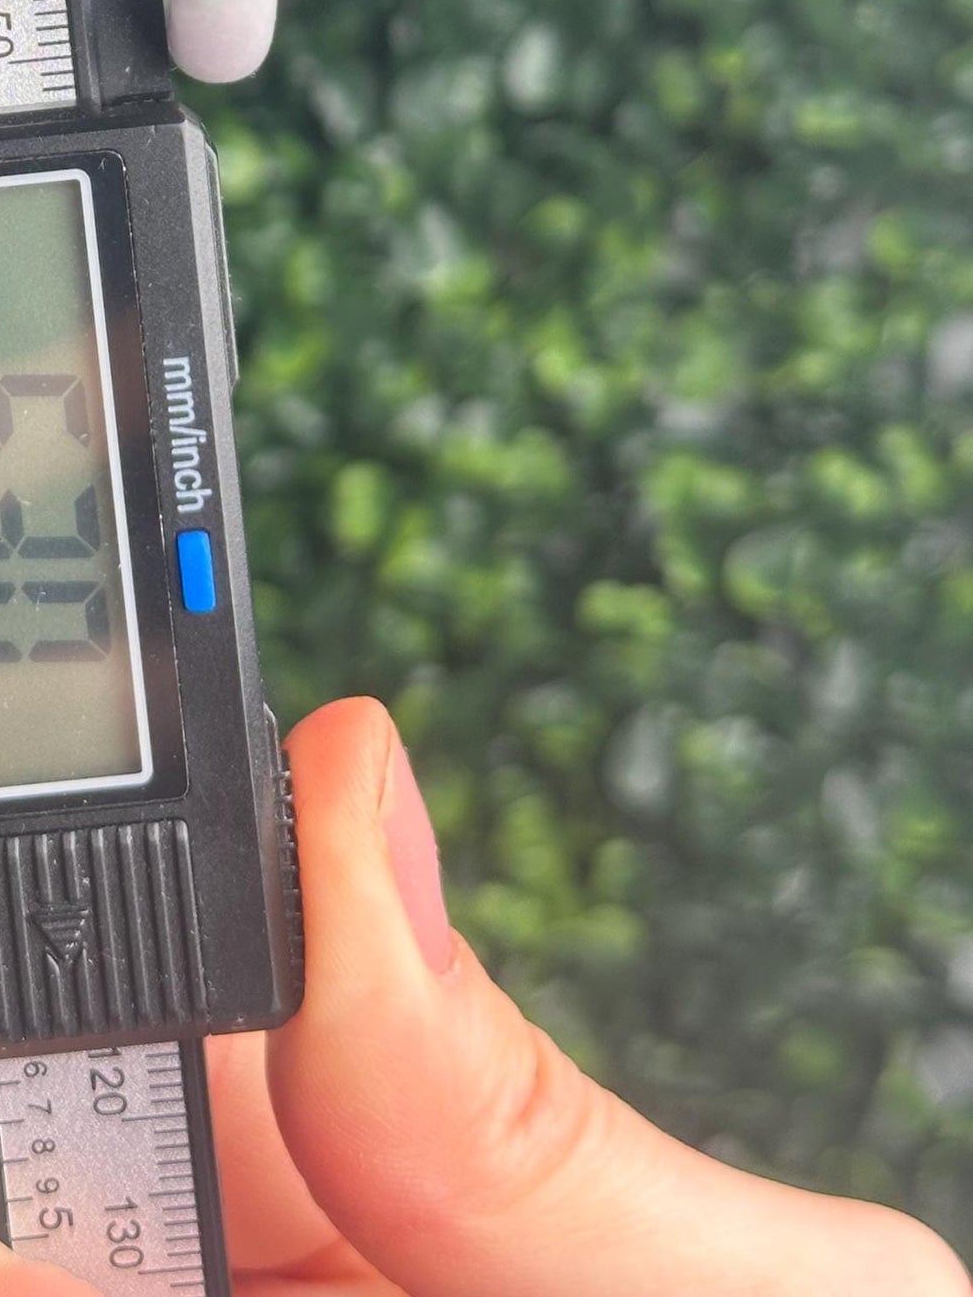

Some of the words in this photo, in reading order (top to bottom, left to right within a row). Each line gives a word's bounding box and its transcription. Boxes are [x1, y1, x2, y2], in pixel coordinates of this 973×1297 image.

[163, 356, 212, 513] mm/inch
[23, 1061, 47, 1078] 6
[87, 1047, 128, 1116] 120
[28, 1099, 52, 1115] 7
[31, 1138, 56, 1154] 8
[36, 1177, 60, 1194] 9
[39, 1207, 74, 1230] 5
[104, 1196, 144, 1269] 130
